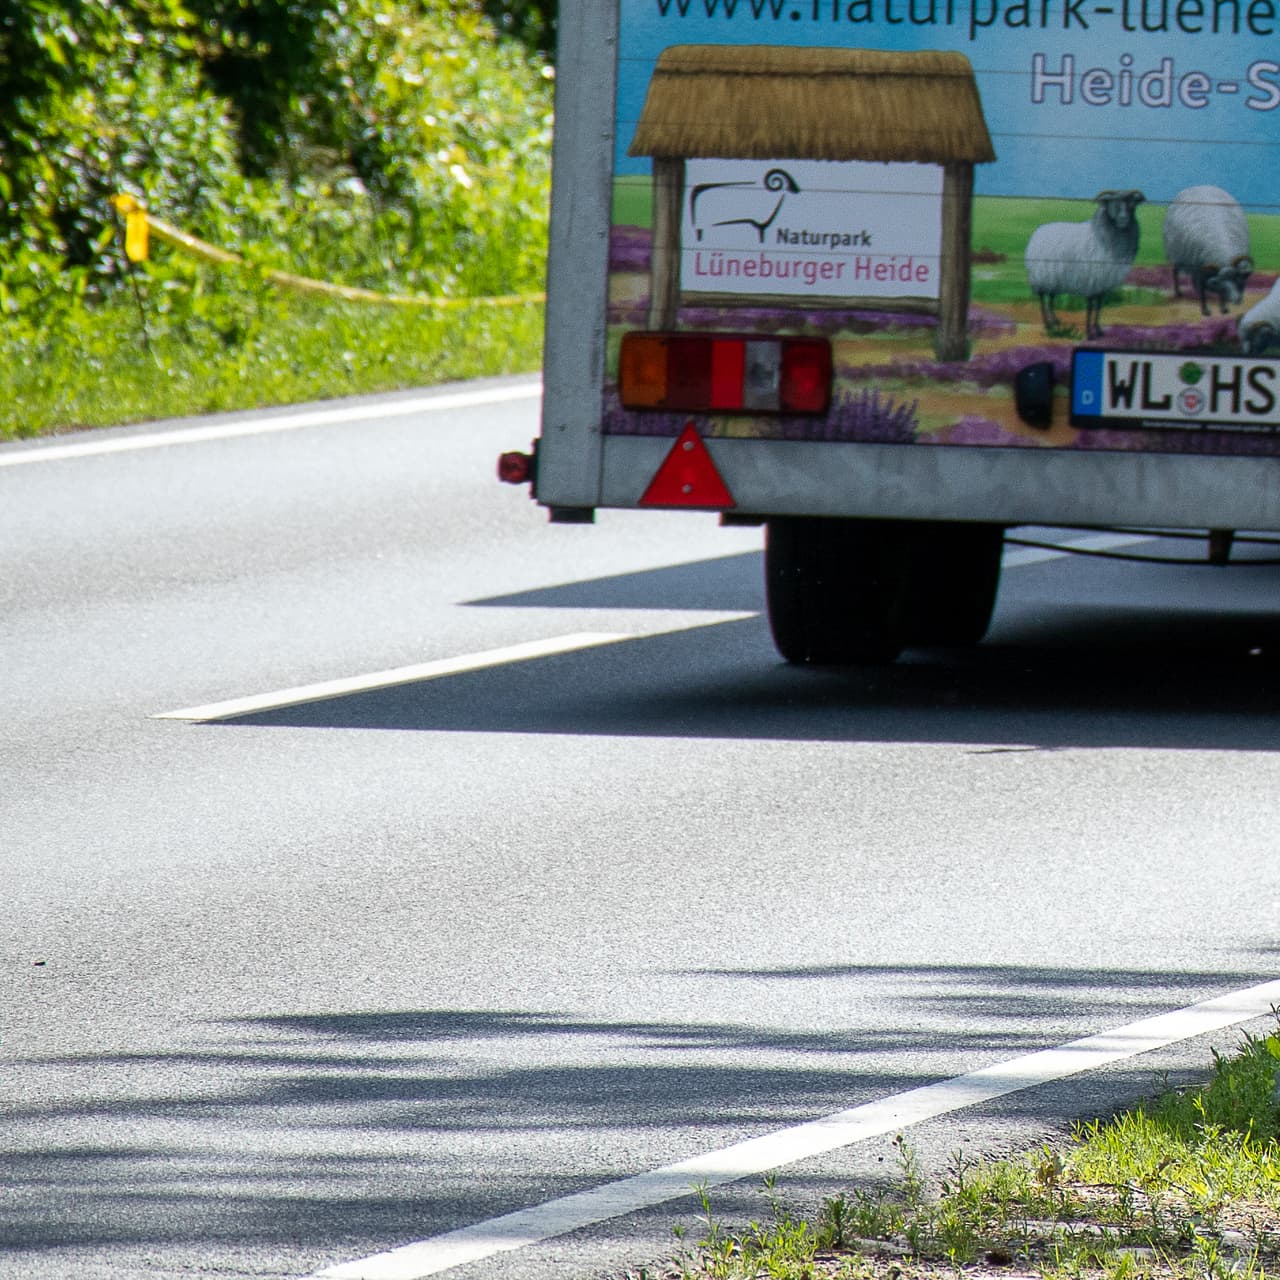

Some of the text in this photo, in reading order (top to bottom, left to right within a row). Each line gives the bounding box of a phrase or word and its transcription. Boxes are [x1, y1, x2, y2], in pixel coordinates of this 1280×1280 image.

[776, 228, 873, 249] Naturpark
[694, 251, 931, 285] Lüneburger Heide
[1081, 391, 1094, 405] D
[1107, 360, 1173, 411] WL
[1208, 363, 1278, 416] HS
